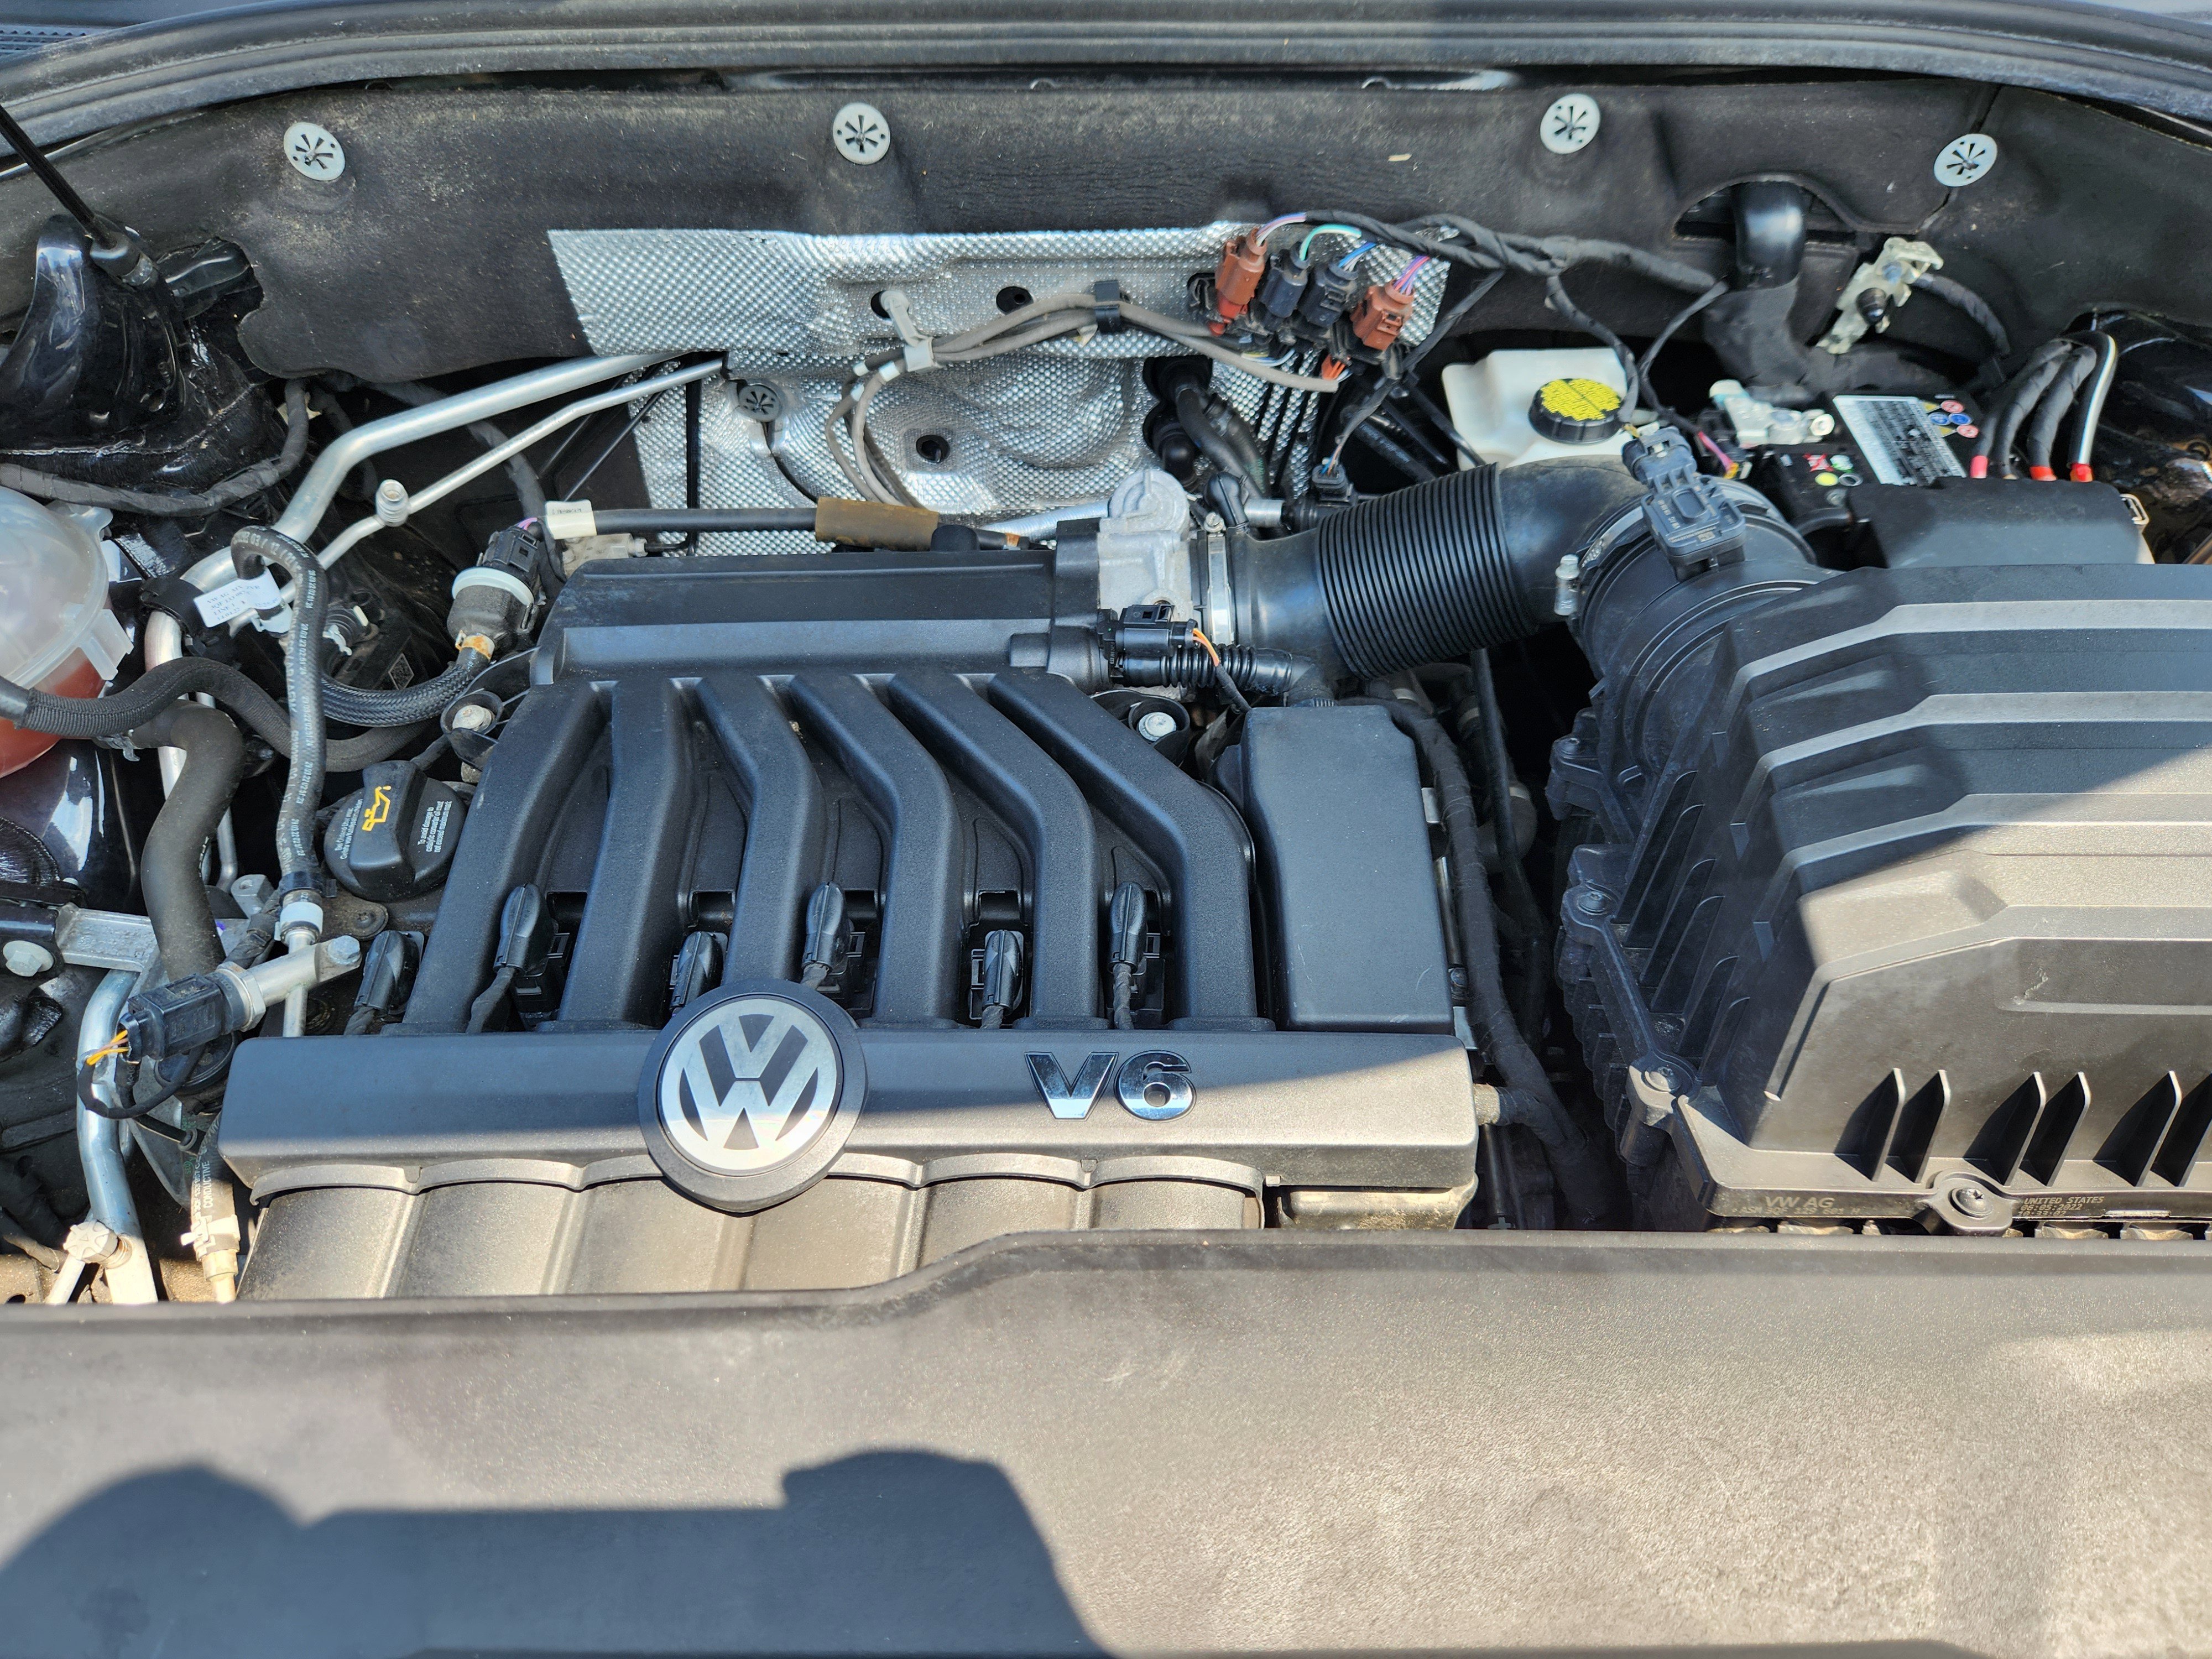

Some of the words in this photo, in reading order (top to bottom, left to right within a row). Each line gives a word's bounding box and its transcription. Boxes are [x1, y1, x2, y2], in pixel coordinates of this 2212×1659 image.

[670, 1005, 828, 1161] VW
[1024, 1050, 1196, 1121] V6
[202, 1160, 213, 1209] CONDUCTIVE
[1765, 1196, 1802, 1207] VW
[1803, 1197, 1835, 1208] AG
